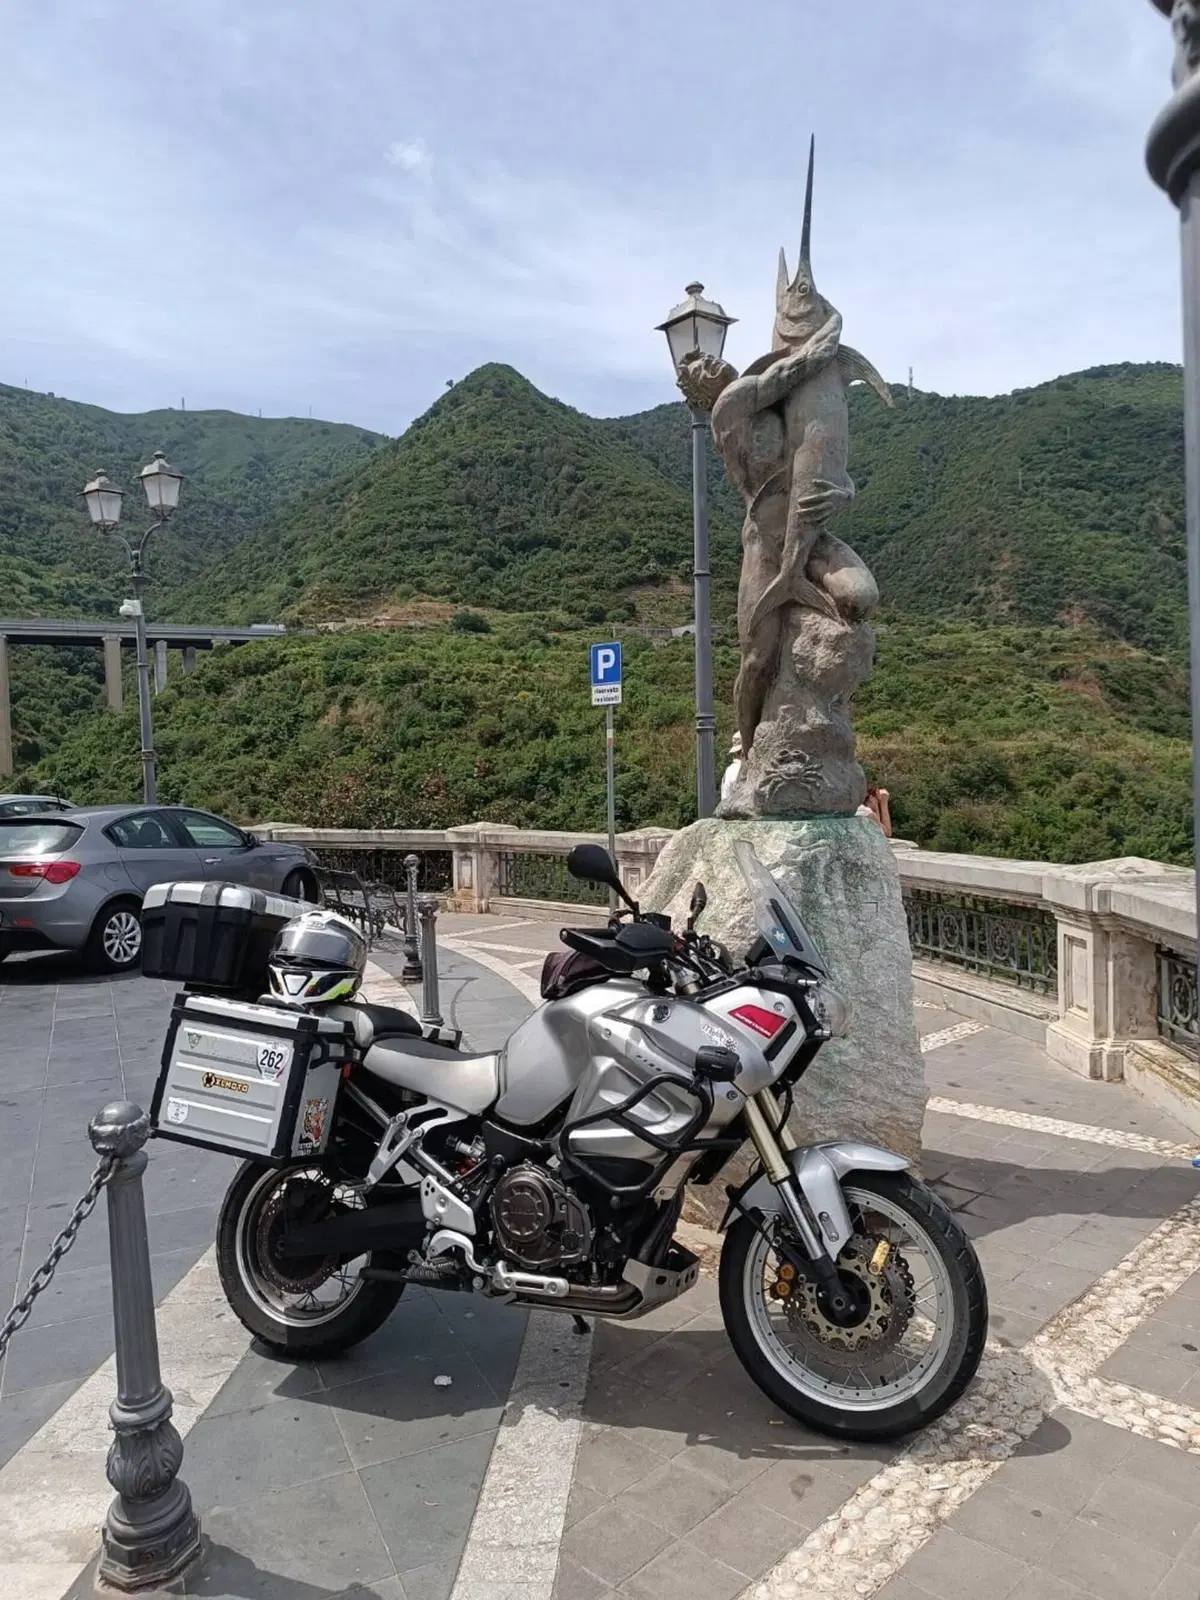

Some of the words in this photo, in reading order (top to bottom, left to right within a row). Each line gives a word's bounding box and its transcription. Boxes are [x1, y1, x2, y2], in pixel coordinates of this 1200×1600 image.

[597, 648, 615, 680] P
[260, 1049, 283, 1069] 262
[215, 1078, 249, 1092] XLMOTO
